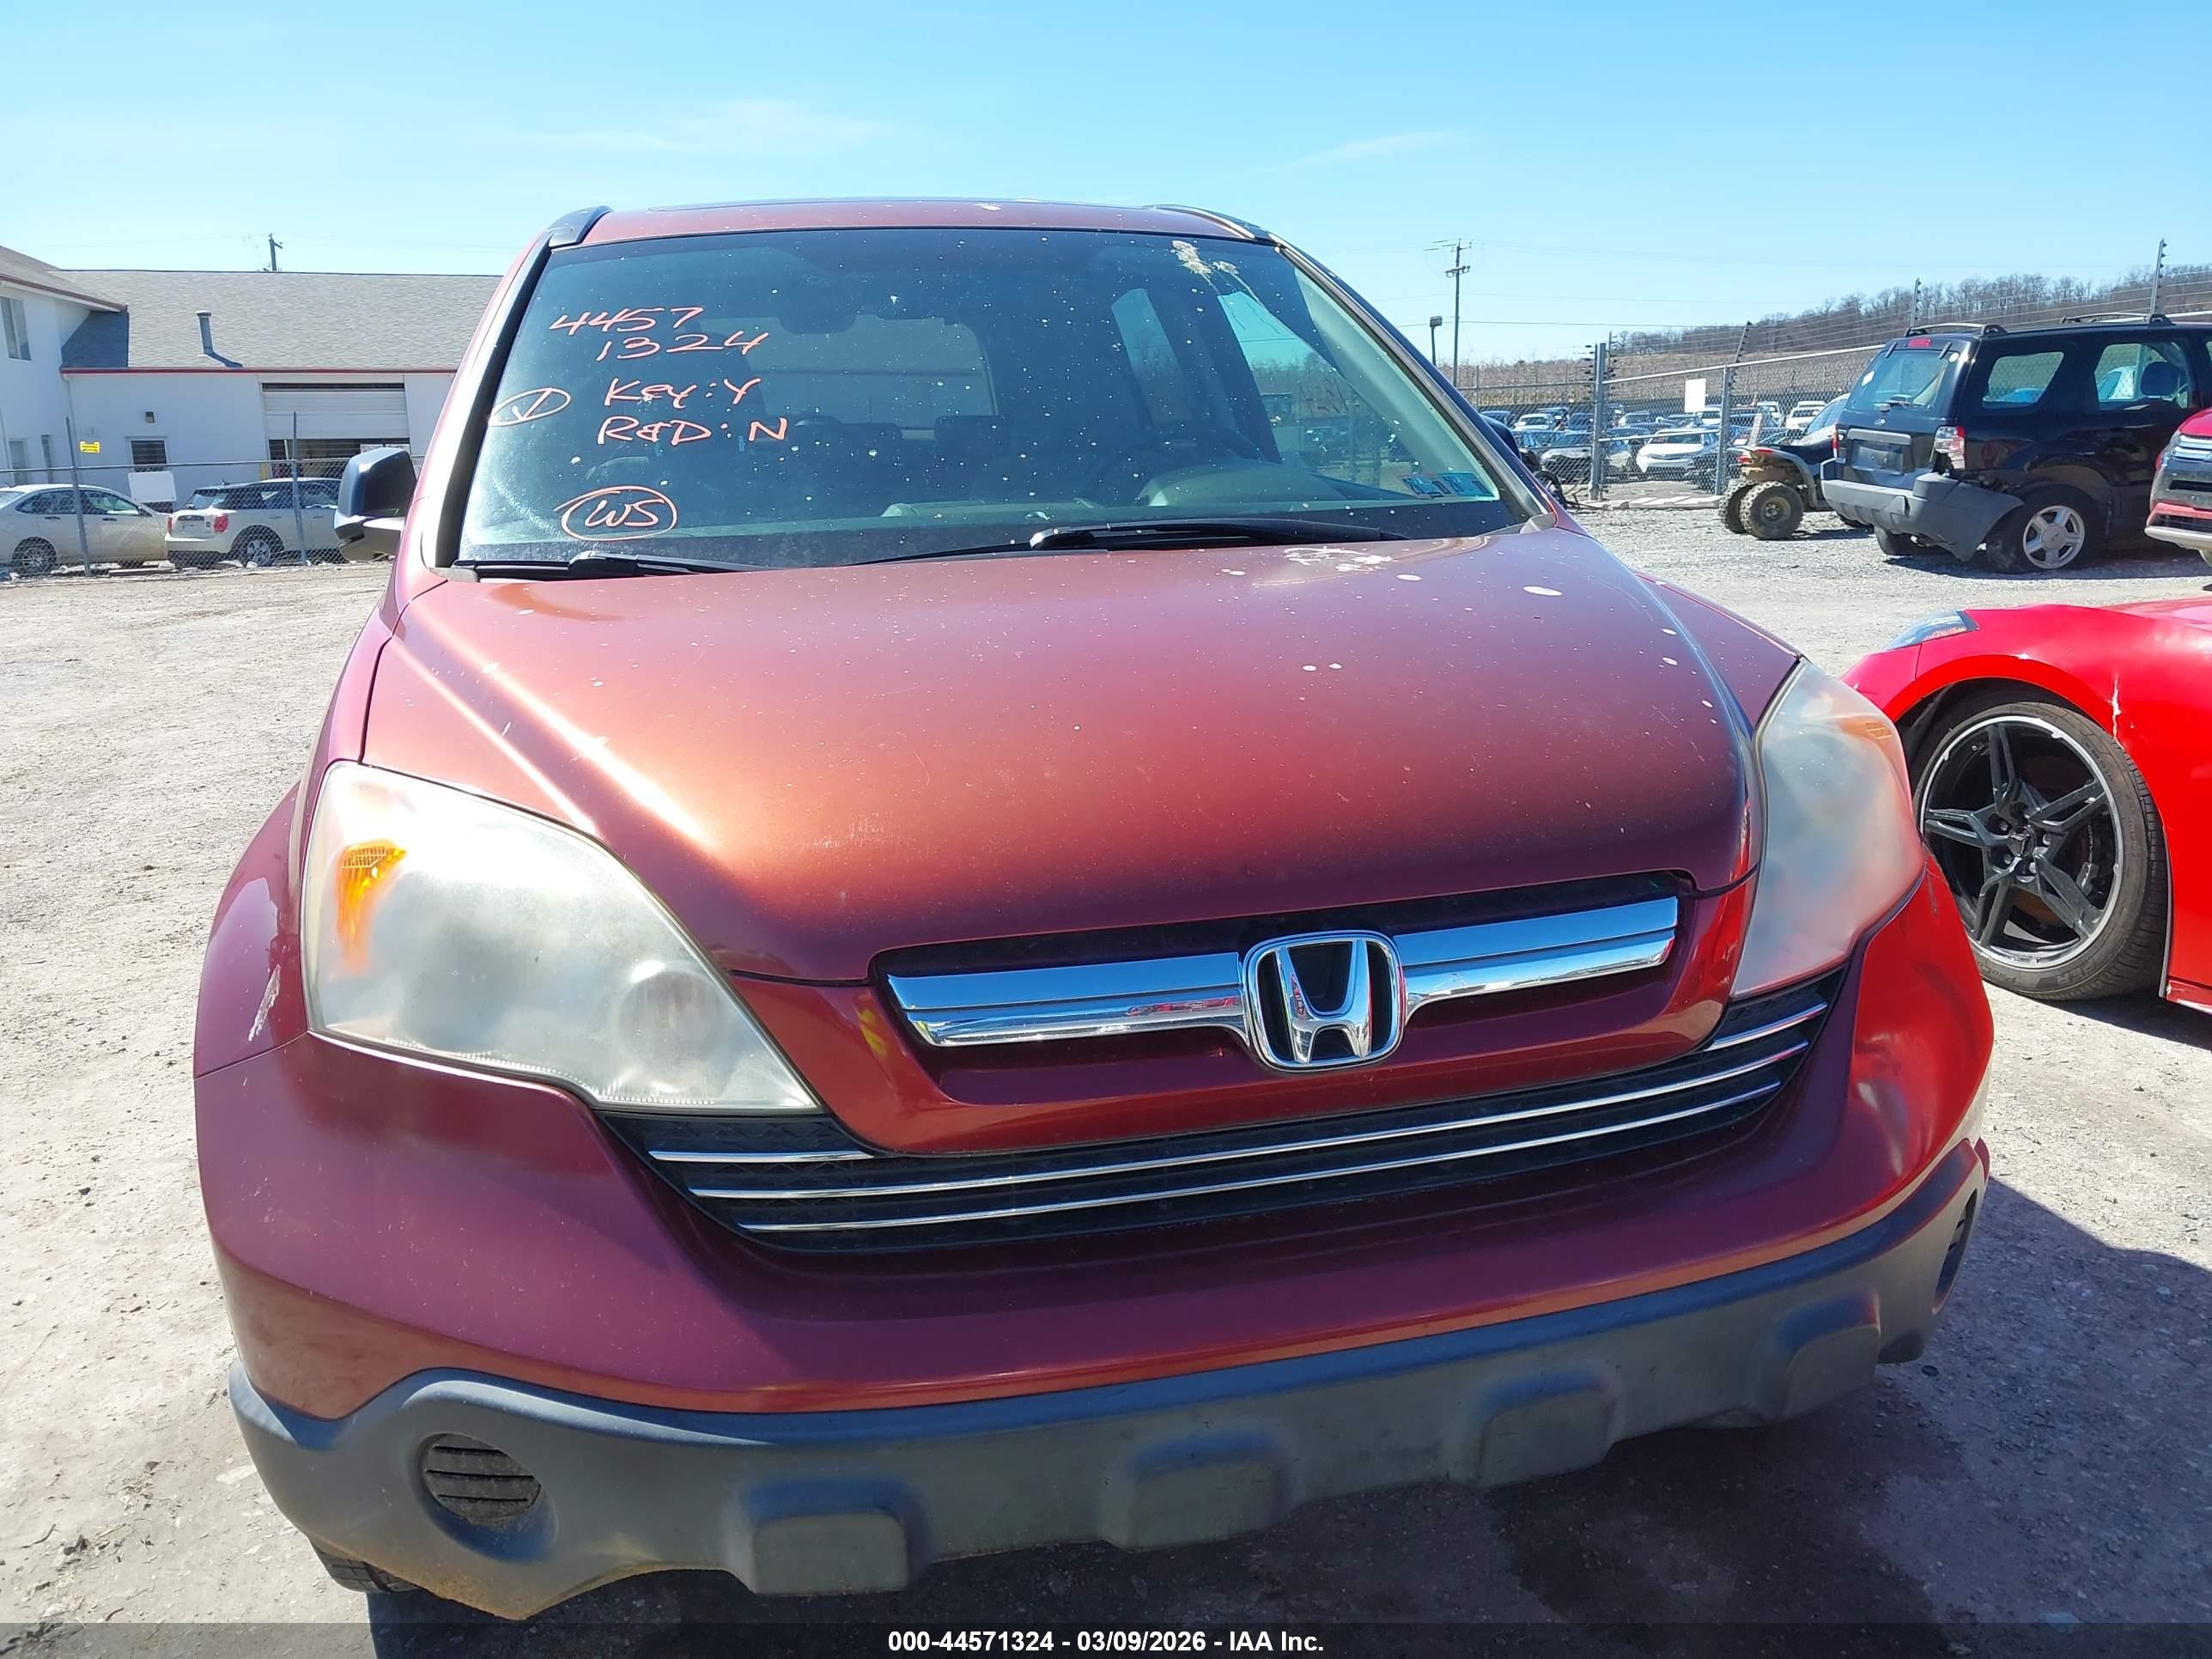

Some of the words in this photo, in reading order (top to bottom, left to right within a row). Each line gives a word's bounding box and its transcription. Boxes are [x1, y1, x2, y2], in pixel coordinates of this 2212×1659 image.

[550, 307, 704, 336] 4457
[596, 331, 769, 362] 1324
[584, 498, 668, 528] WS
